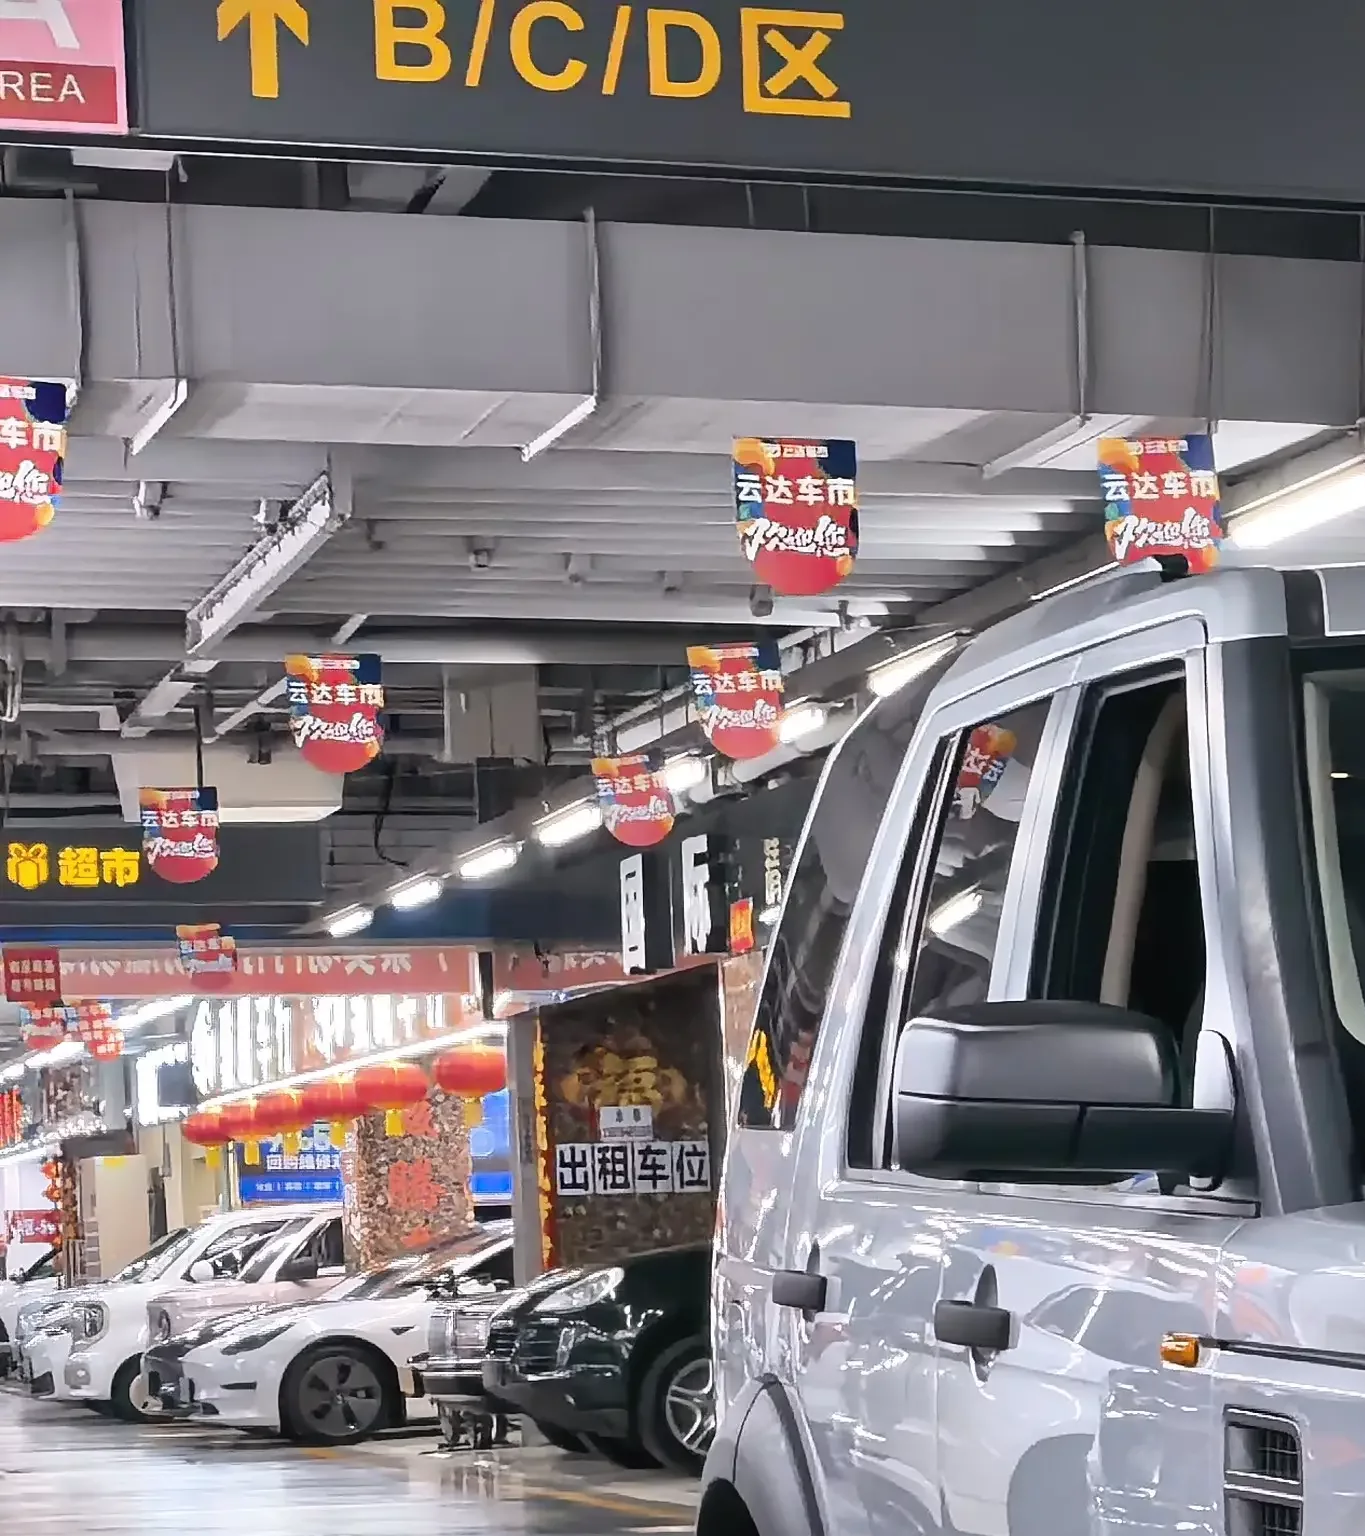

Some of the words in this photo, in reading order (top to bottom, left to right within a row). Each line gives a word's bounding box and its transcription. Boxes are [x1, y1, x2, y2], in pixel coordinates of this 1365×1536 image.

[373, 0, 852, 118] B/C/D区
[736, 473, 855, 506] 云达车市
[1100, 469, 1217, 502] 云达车市
[745, 514, 850, 561] 欢迎您
[1113, 506, 1215, 560] 欢迎您
[289, 680, 385, 706] 云达车市
[691, 668, 783, 695] 云达车市
[291, 712, 376, 749] 欢迎您
[700, 698, 778, 739] 欢迎您
[142, 809, 219, 828] 云达车市
[57, 845, 140, 888] 超市
[557, 1143, 710, 1192] 出租车位
